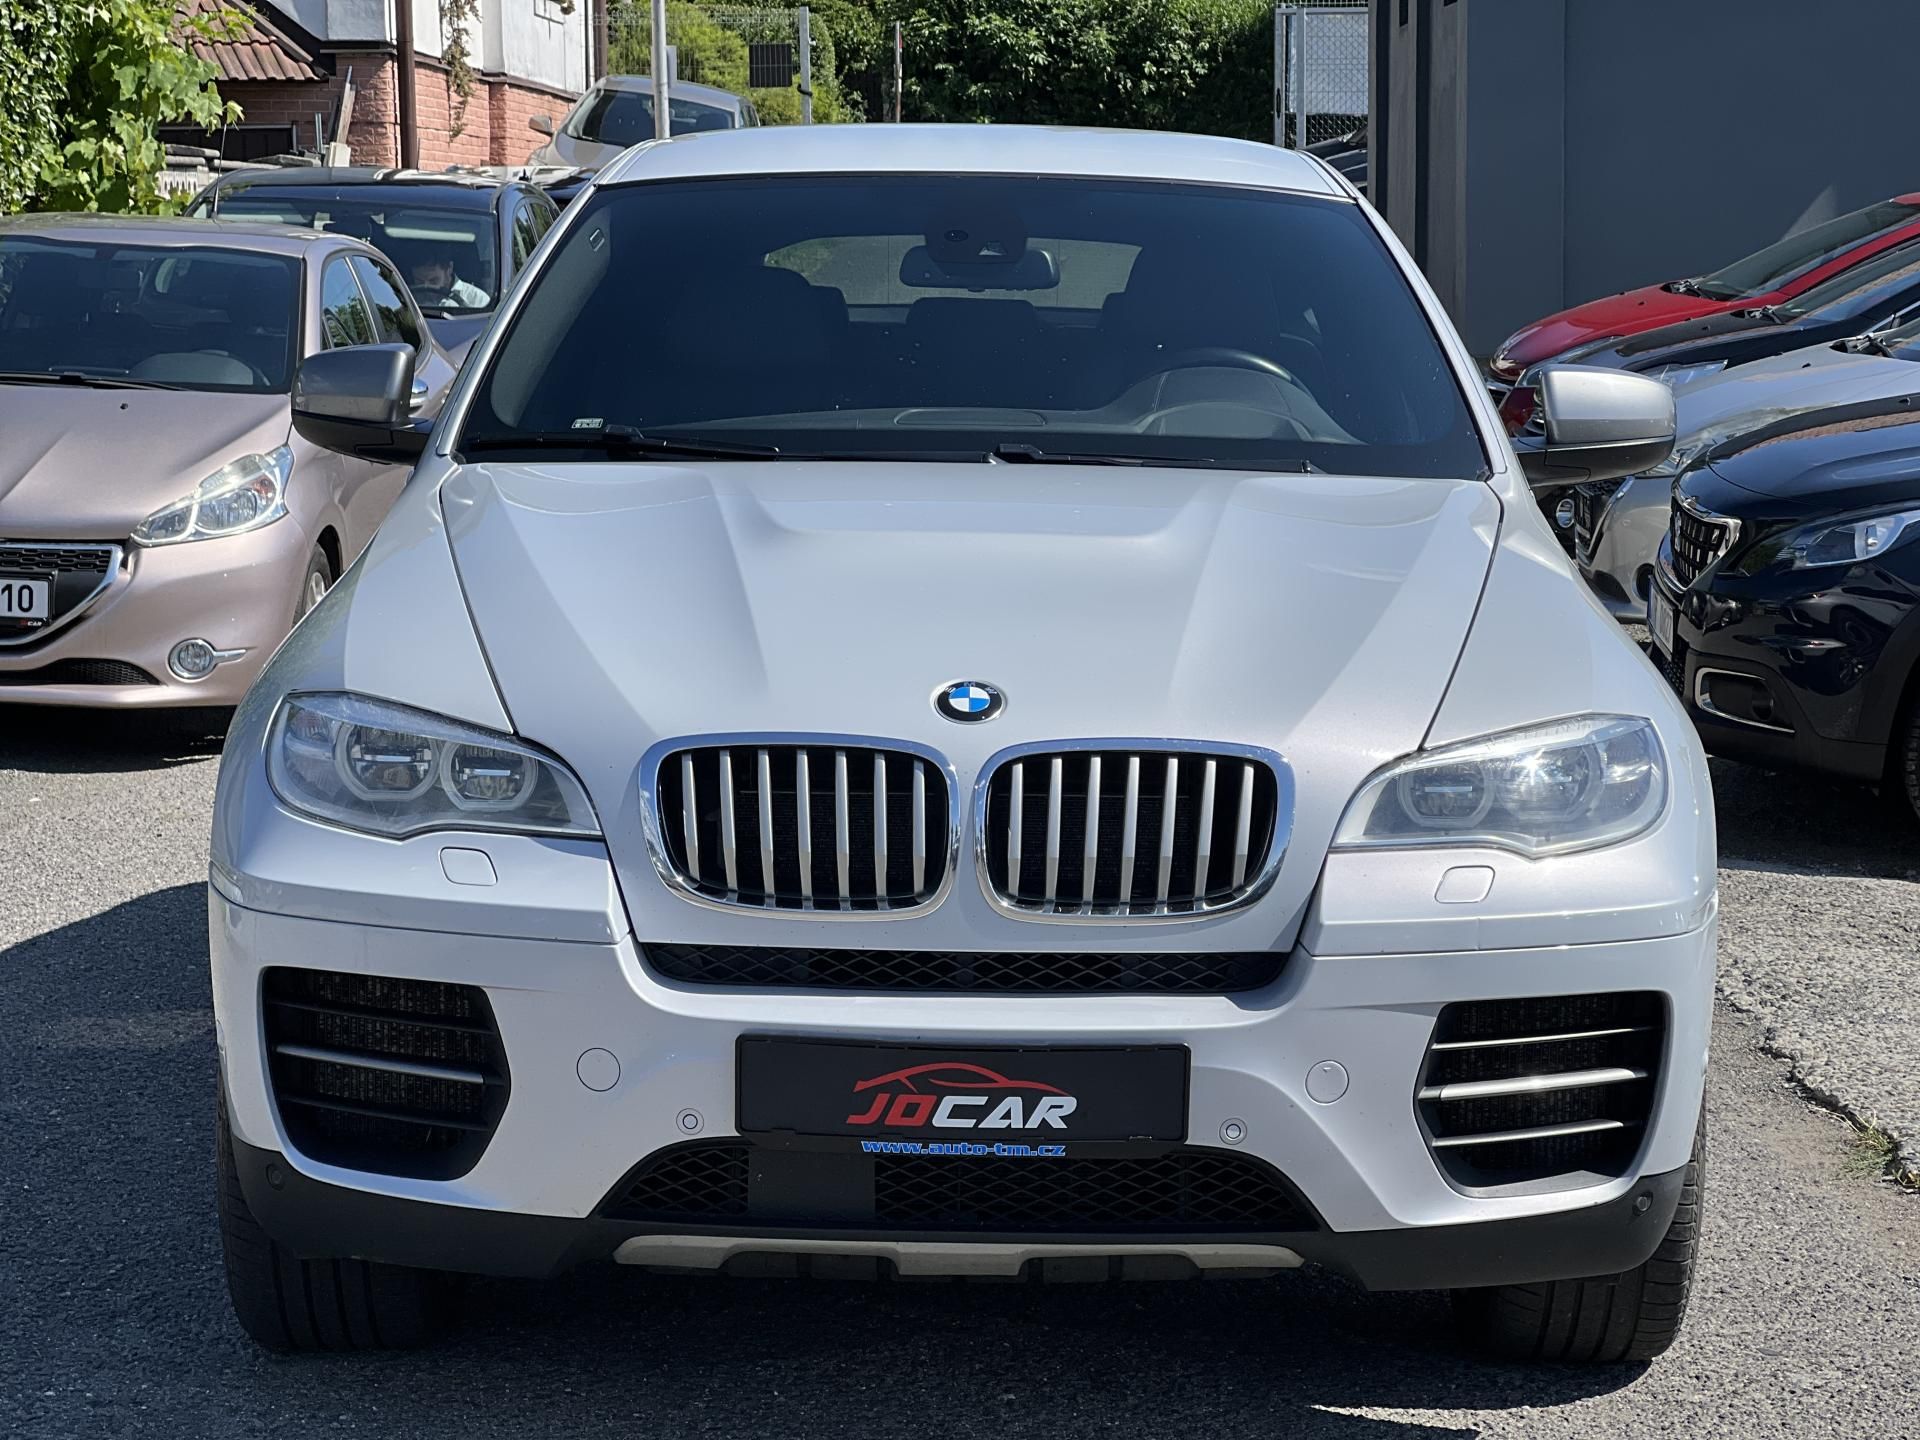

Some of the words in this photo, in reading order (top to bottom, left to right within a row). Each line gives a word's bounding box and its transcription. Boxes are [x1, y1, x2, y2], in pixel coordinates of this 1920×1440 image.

[1, 584, 34, 613] 10
[847, 1093, 1078, 1129] JOCAR
[861, 1140, 1067, 1157] www.auto-tm.cz
